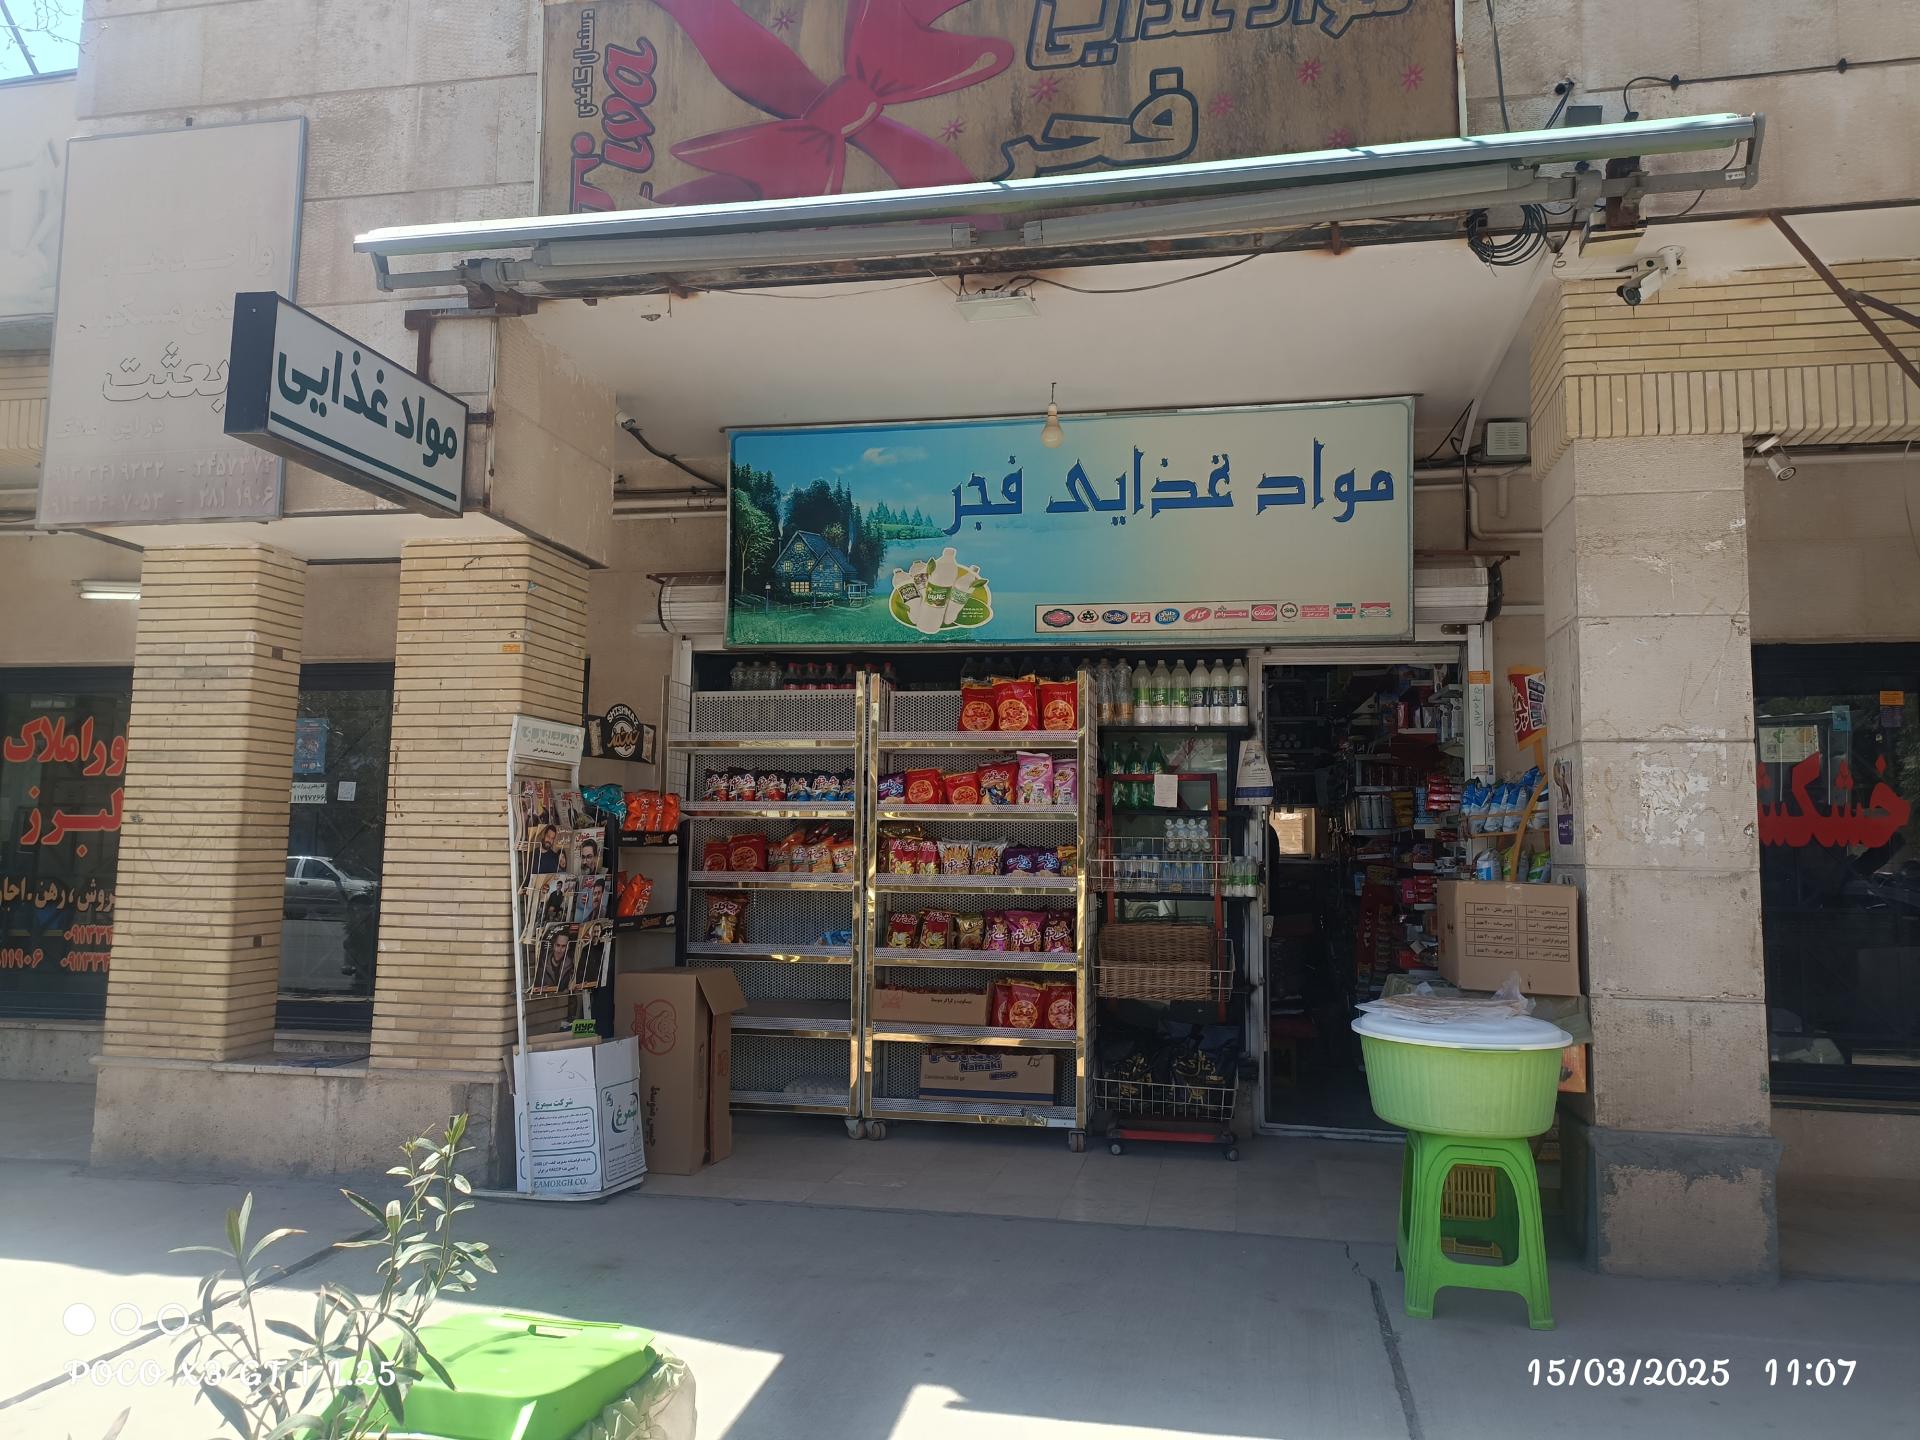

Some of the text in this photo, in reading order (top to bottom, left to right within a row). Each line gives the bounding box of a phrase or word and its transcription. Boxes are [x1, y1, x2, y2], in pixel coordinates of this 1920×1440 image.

[277, 350, 459, 468] مواد غذایی
[941, 436, 1396, 537] مواد غذایی فجر
[3, 716, 95, 764] املاک
[1757, 750, 1912, 849] خشکش
[0, 947, 44, 969] ۱۱۹۰۶
[532, 1179, 574, 1189] EAMORGH
